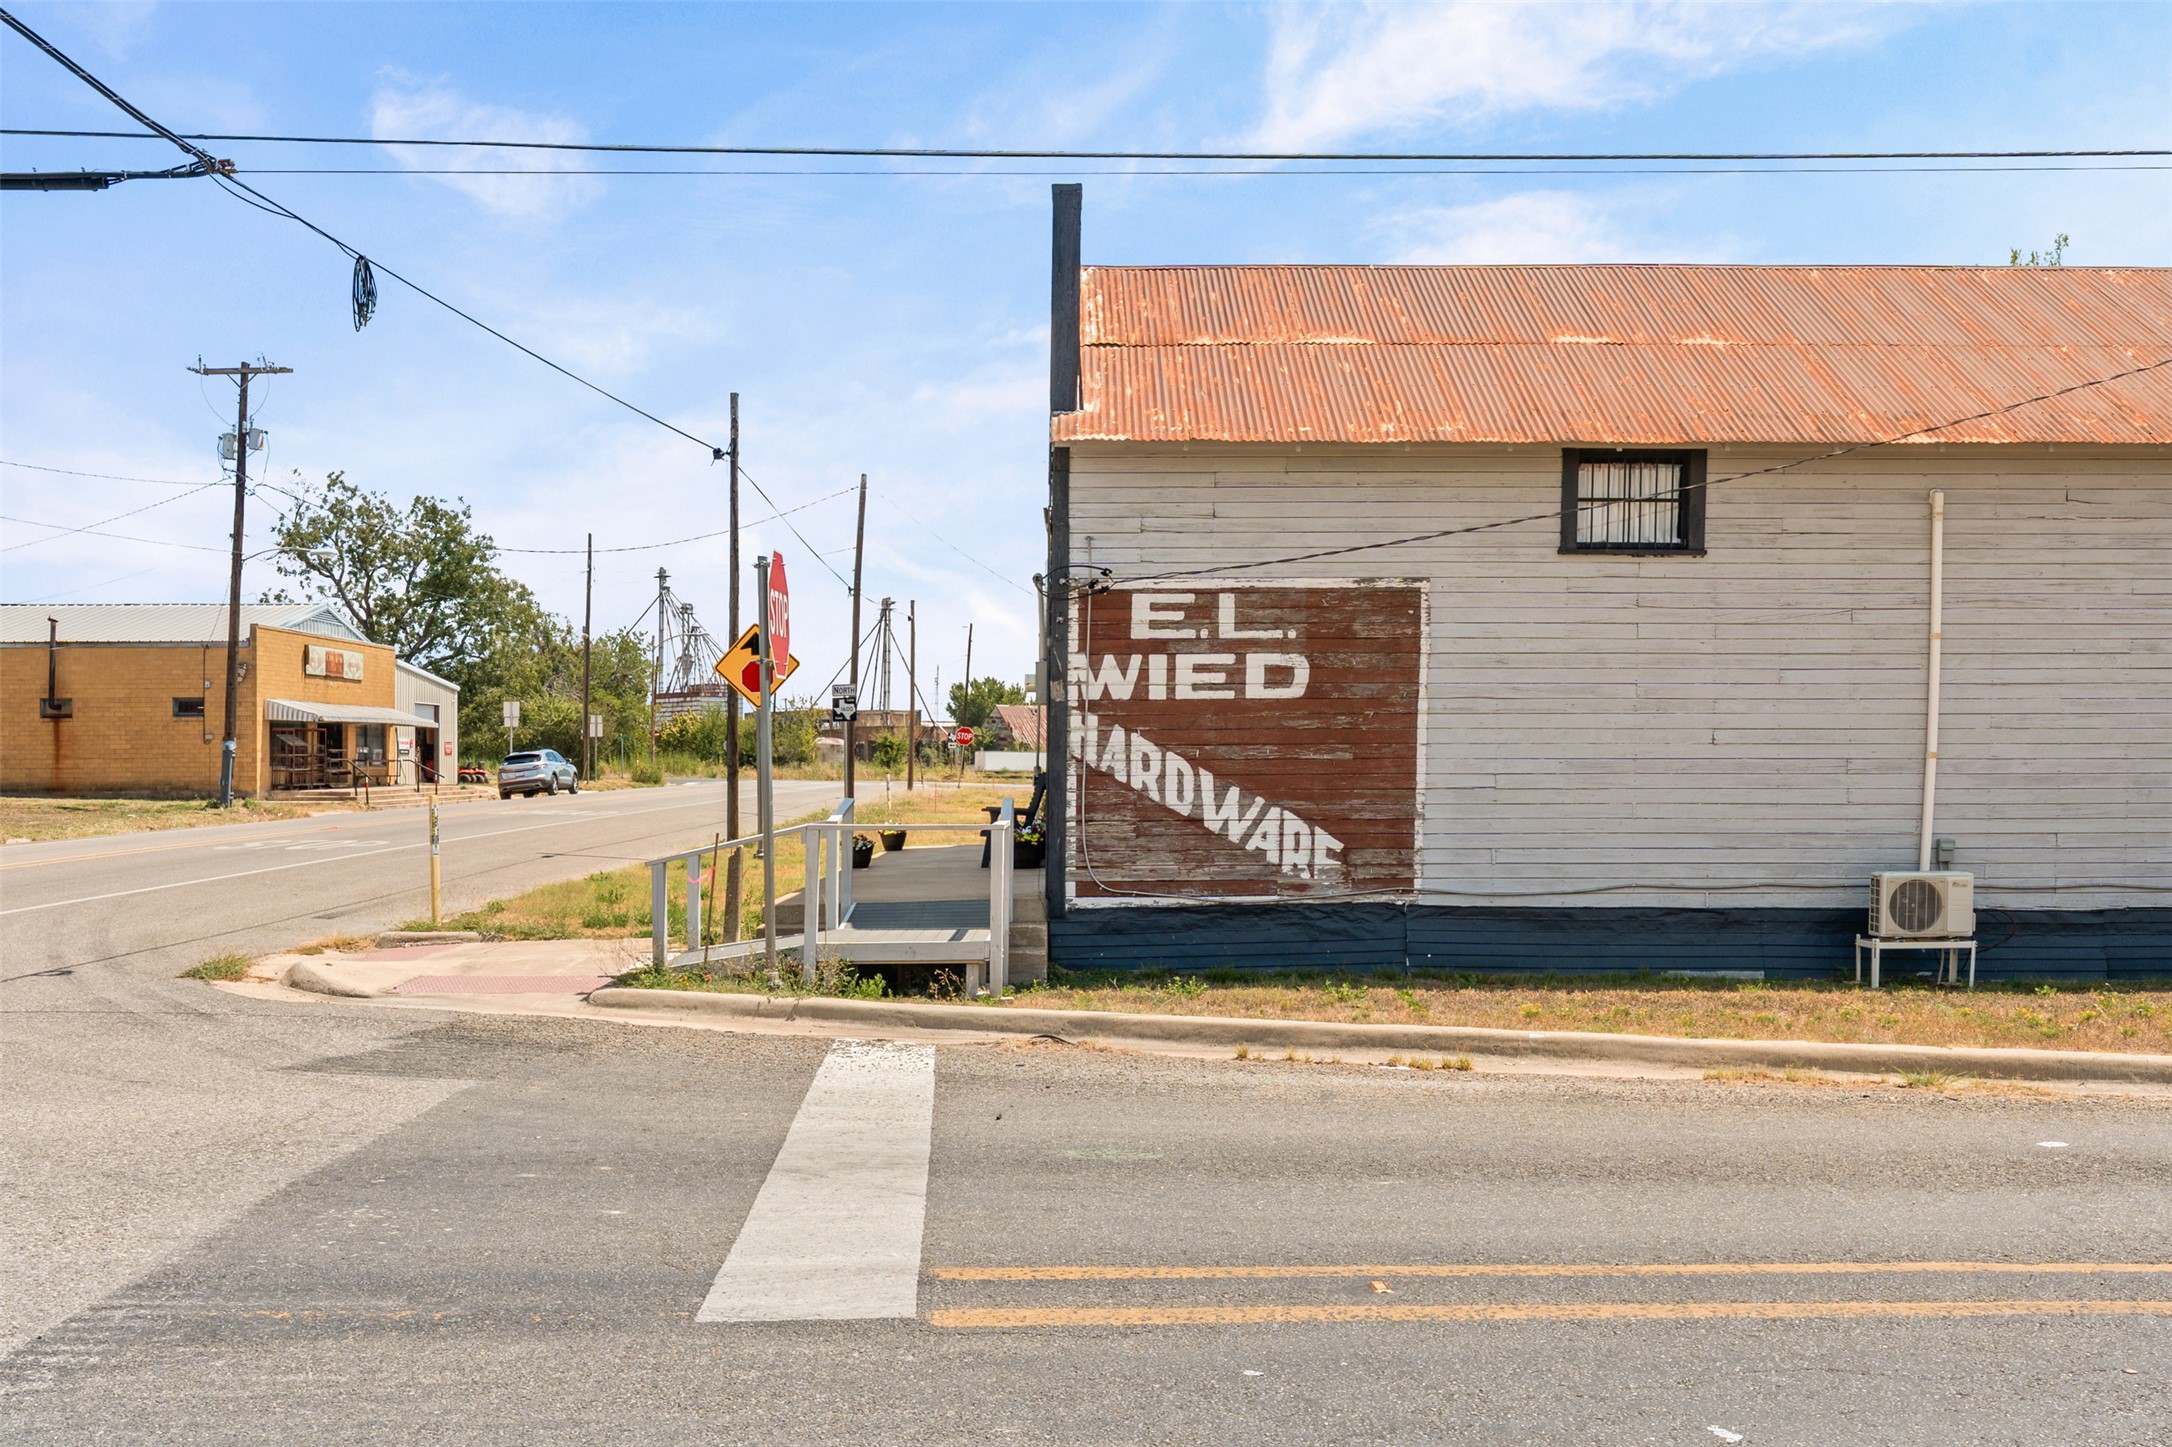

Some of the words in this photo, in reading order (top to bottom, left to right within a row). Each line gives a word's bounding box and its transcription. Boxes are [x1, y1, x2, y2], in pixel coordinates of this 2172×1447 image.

[769, 588, 788, 638] STOP
[834, 686, 855, 694] NORTH
[1071, 653, 1310, 700] WIED
[956, 732, 973, 740] STOP
